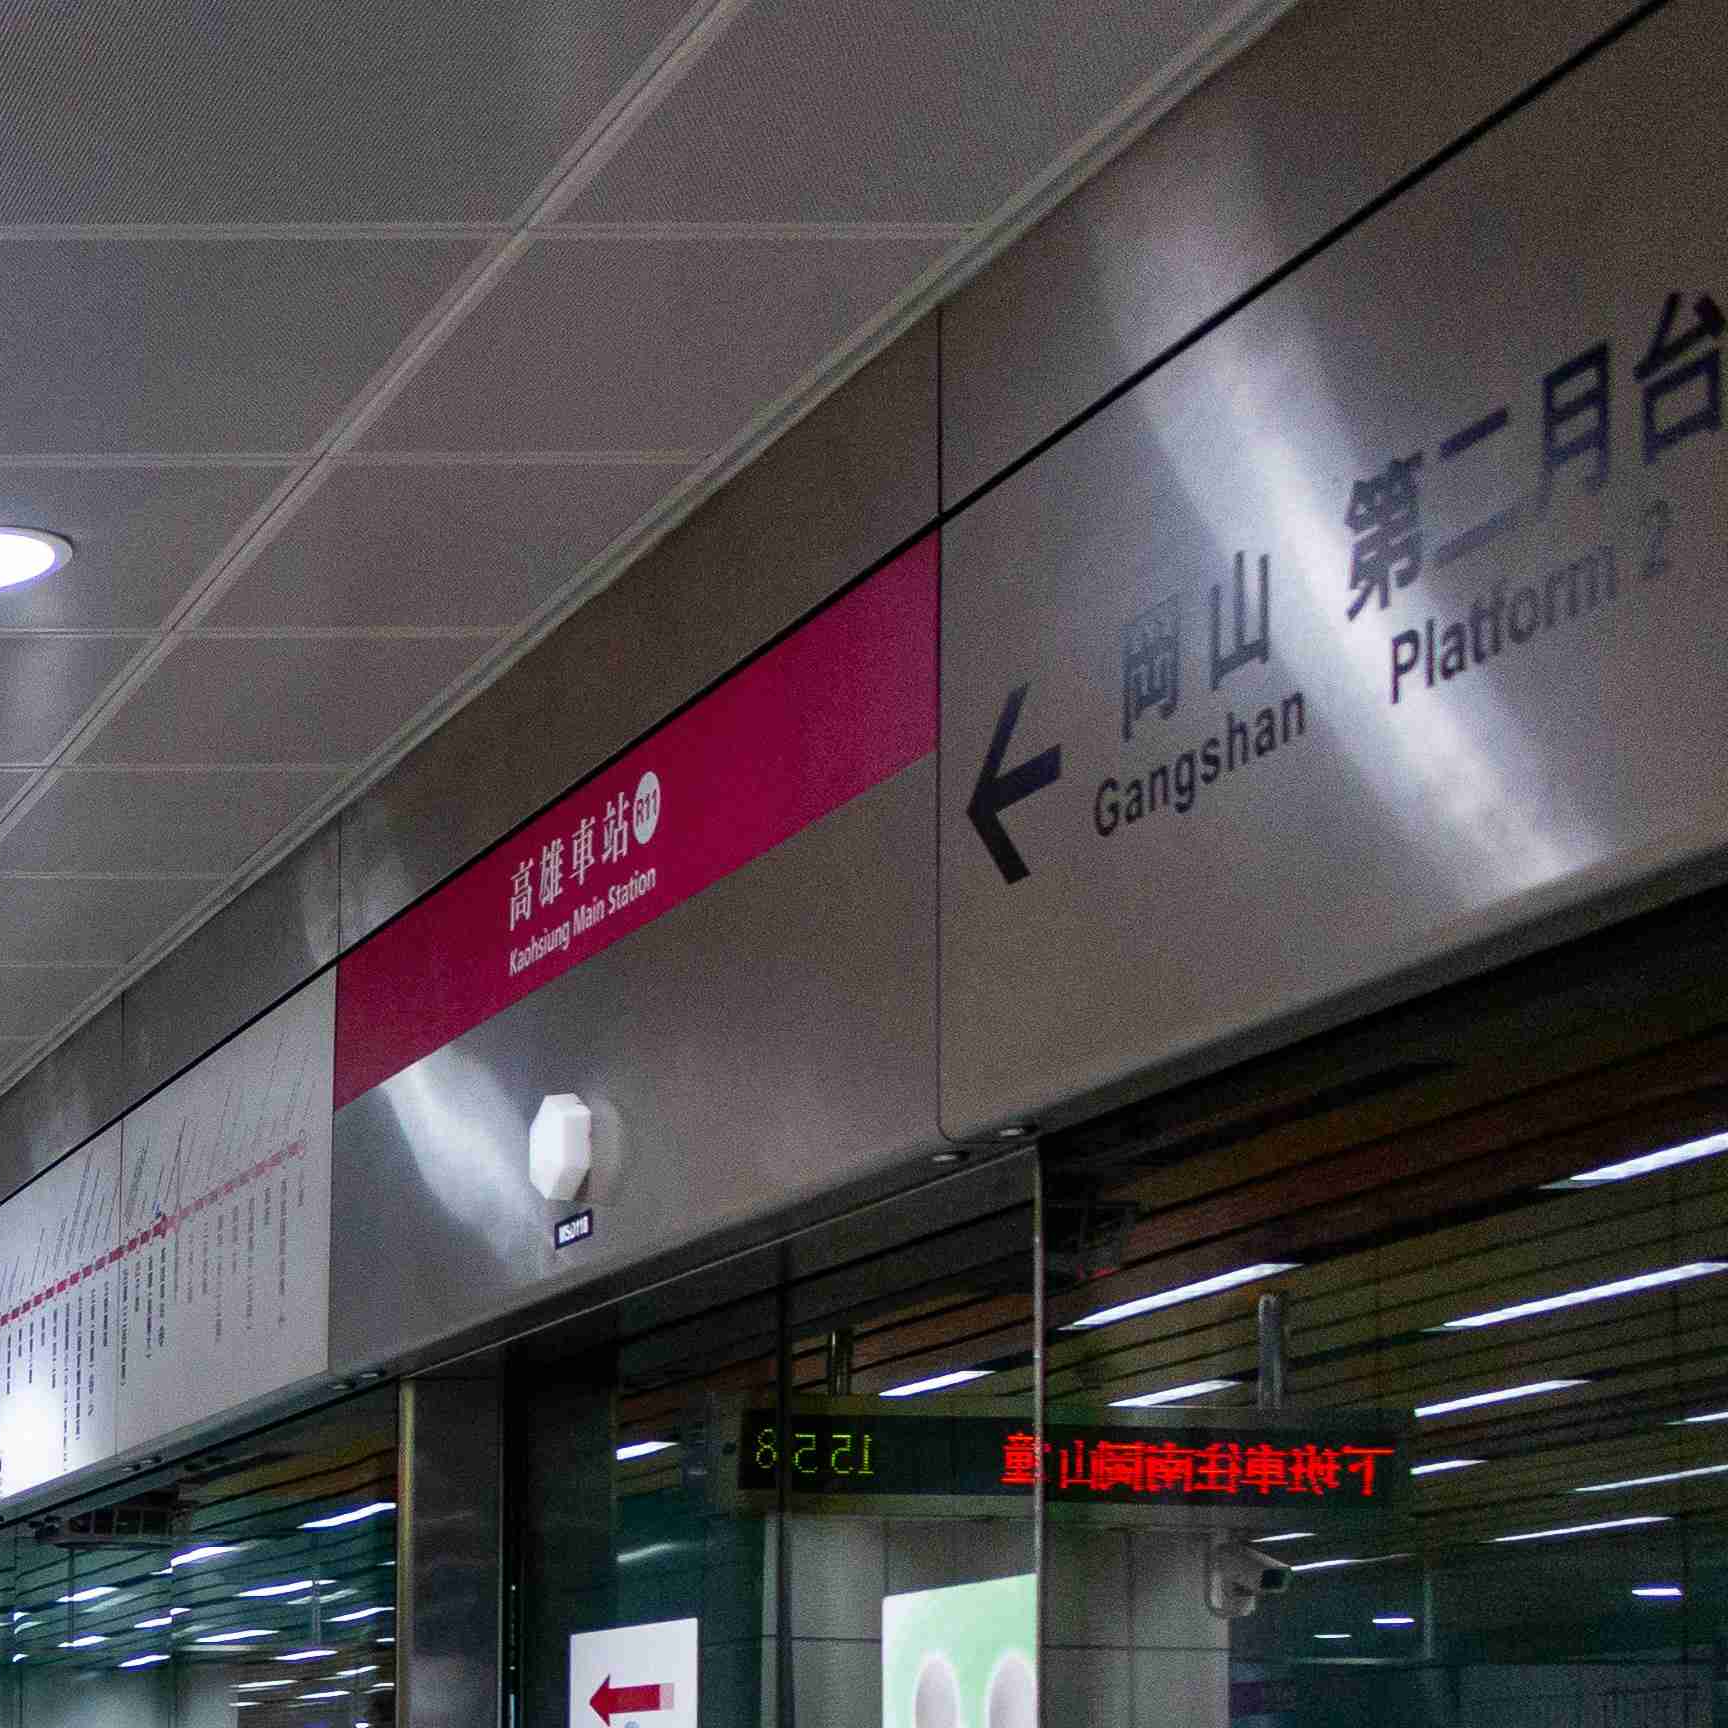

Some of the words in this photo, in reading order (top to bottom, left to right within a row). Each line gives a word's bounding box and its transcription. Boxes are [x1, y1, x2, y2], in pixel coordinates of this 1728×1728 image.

[1347, 293, 1725, 621] 第二月台
[1121, 551, 1271, 743] 岡山
[1391, 544, 1617, 704] Platform
[1095, 692, 1306, 838] Gangshan
[509, 791, 632, 932] 高雄車站
[509, 919, 571, 977] Kaohsiung
[573, 895, 606, 937] Main
[608, 867, 657, 915] Station
